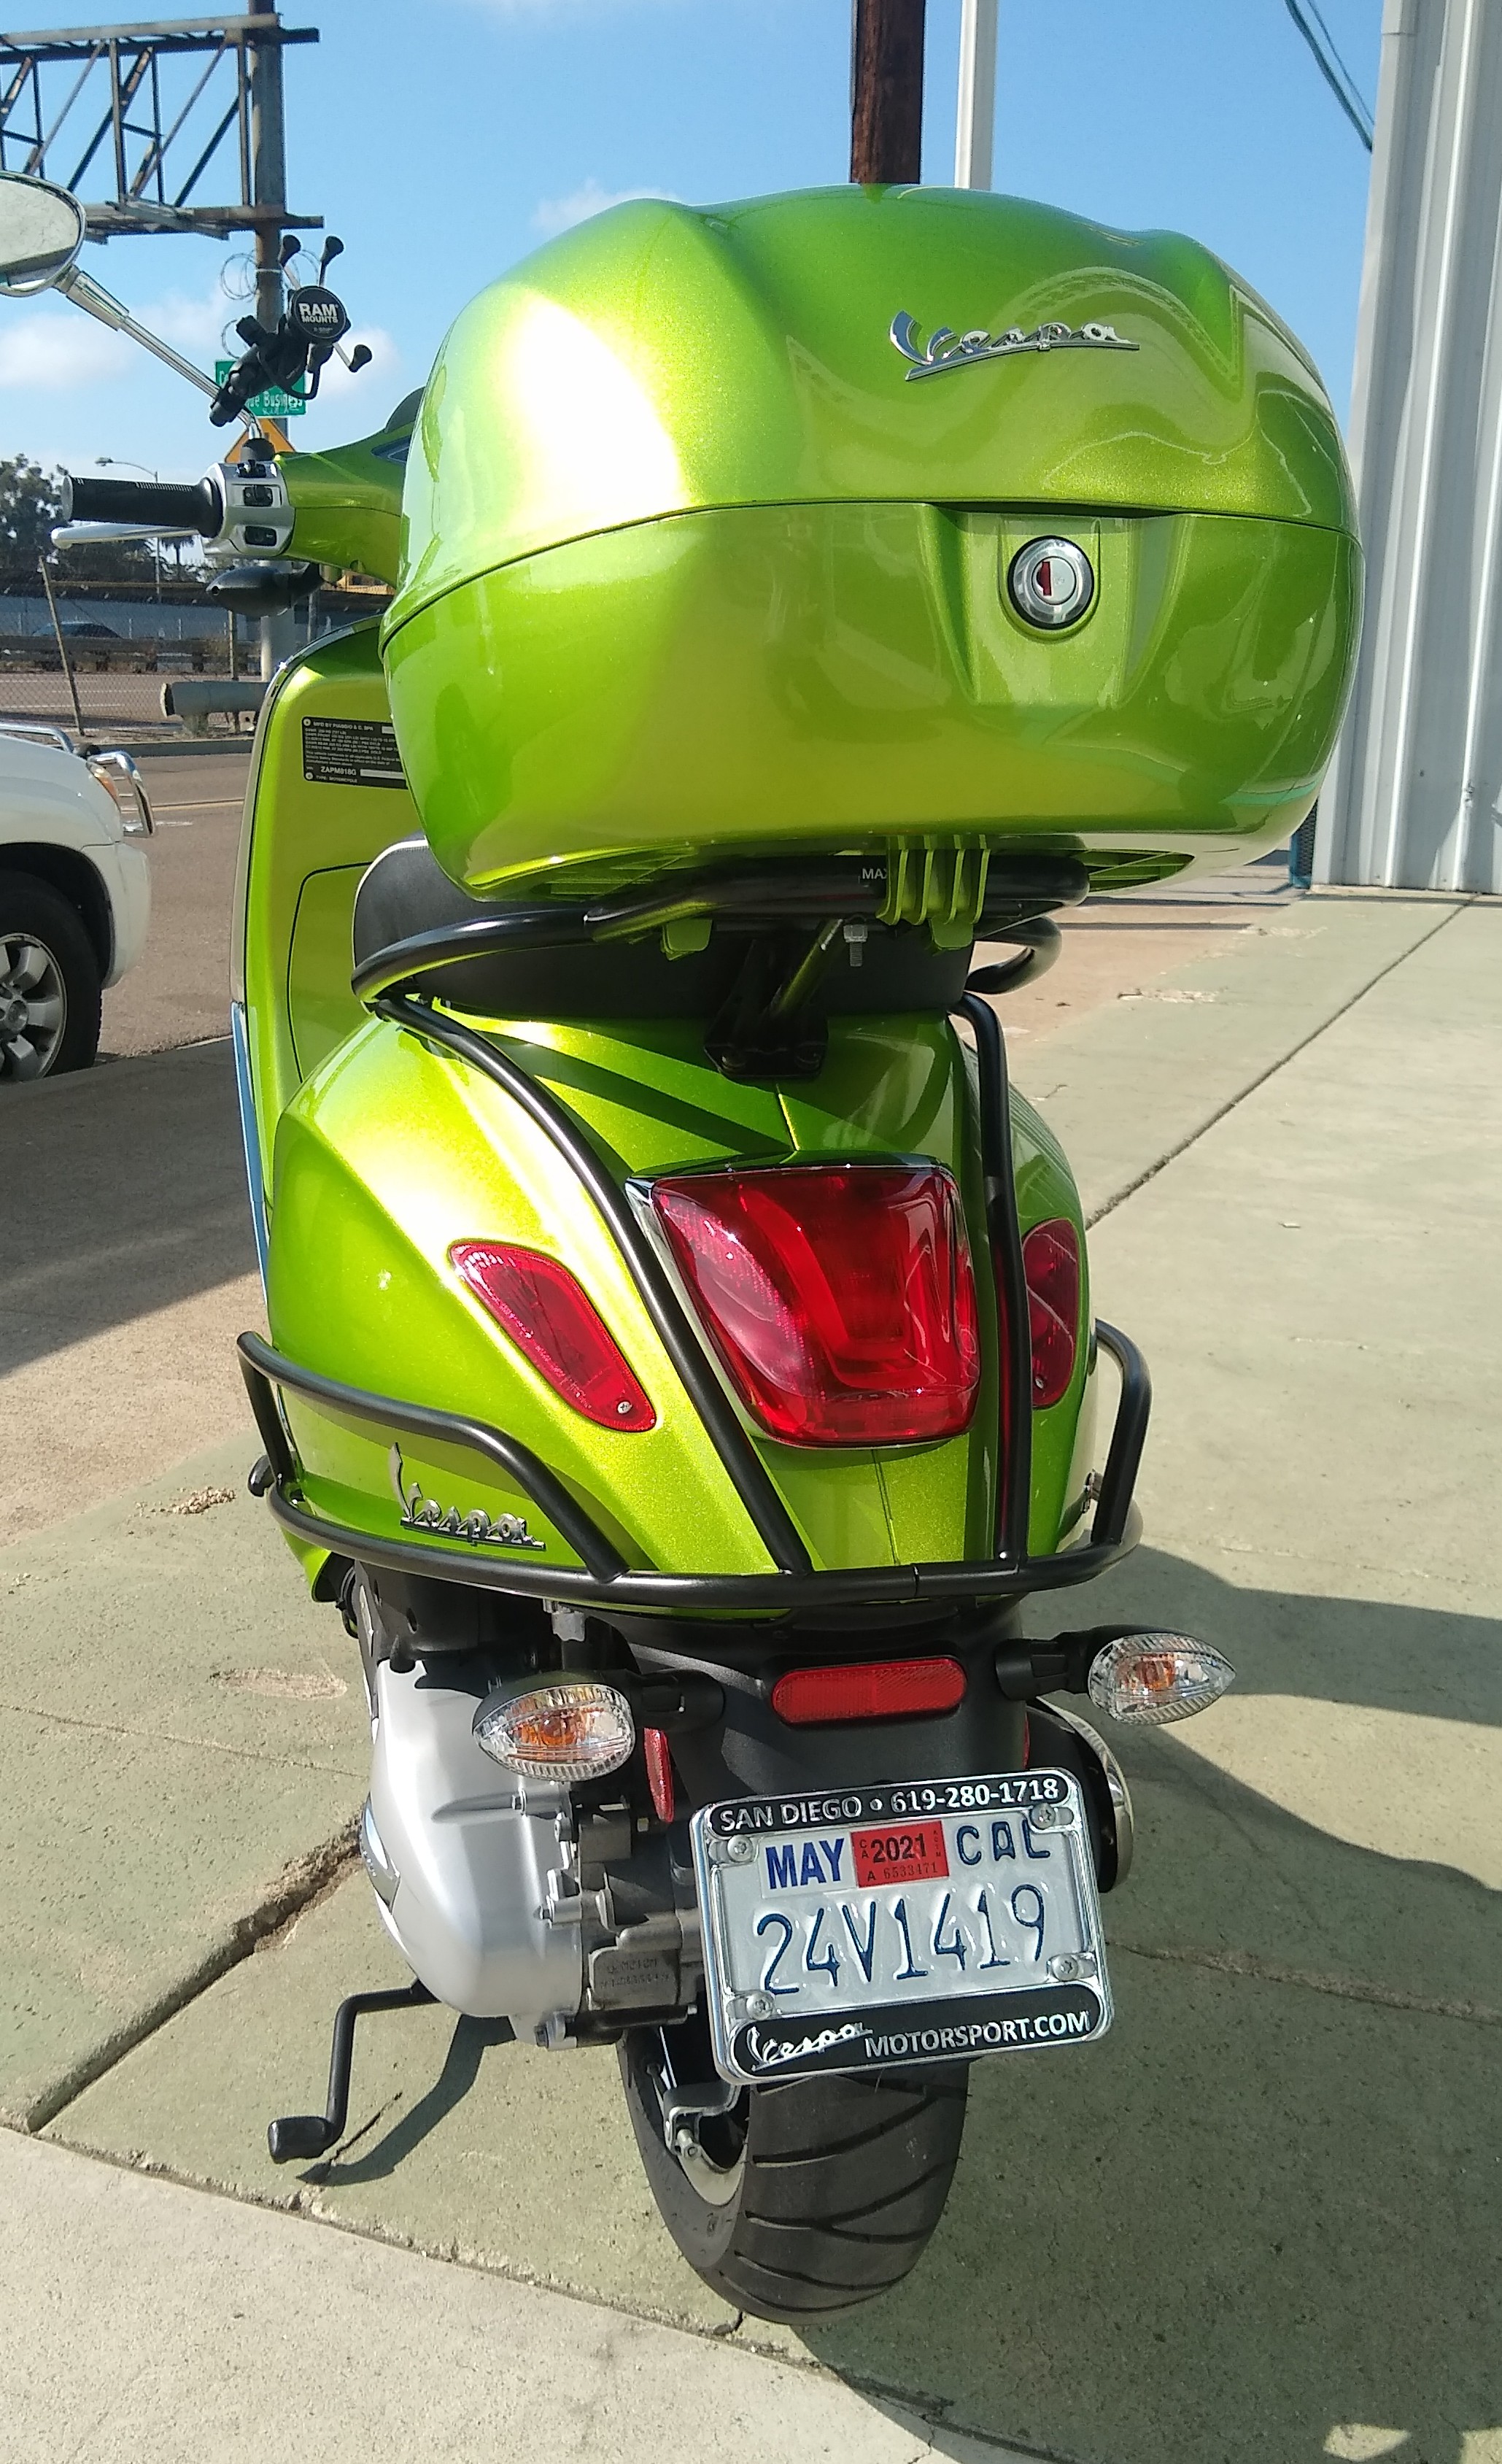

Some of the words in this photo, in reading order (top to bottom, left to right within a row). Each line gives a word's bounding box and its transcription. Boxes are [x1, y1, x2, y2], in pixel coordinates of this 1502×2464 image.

[298, 304, 336, 315] RAM
[301, 315, 338, 323] MOUNTS
[889, 309, 1140, 381] Vespa
[390, 1442, 546, 1551] Vespa
[720, 1806, 774, 1831] SAN
[780, 1796, 862, 1824] DIEGO
[890, 1778, 1058, 1813] 619-280-1718
[765, 1838, 845, 1890] MAY
[871, 1833, 927, 1864] 2021
[956, 1819, 1050, 1866] CAL
[757, 1884, 1046, 1995] 24V1419
[746, 2022, 873, 2072] Vespa
[865, 2010, 1091, 2058] MOTORSPORT.COM
